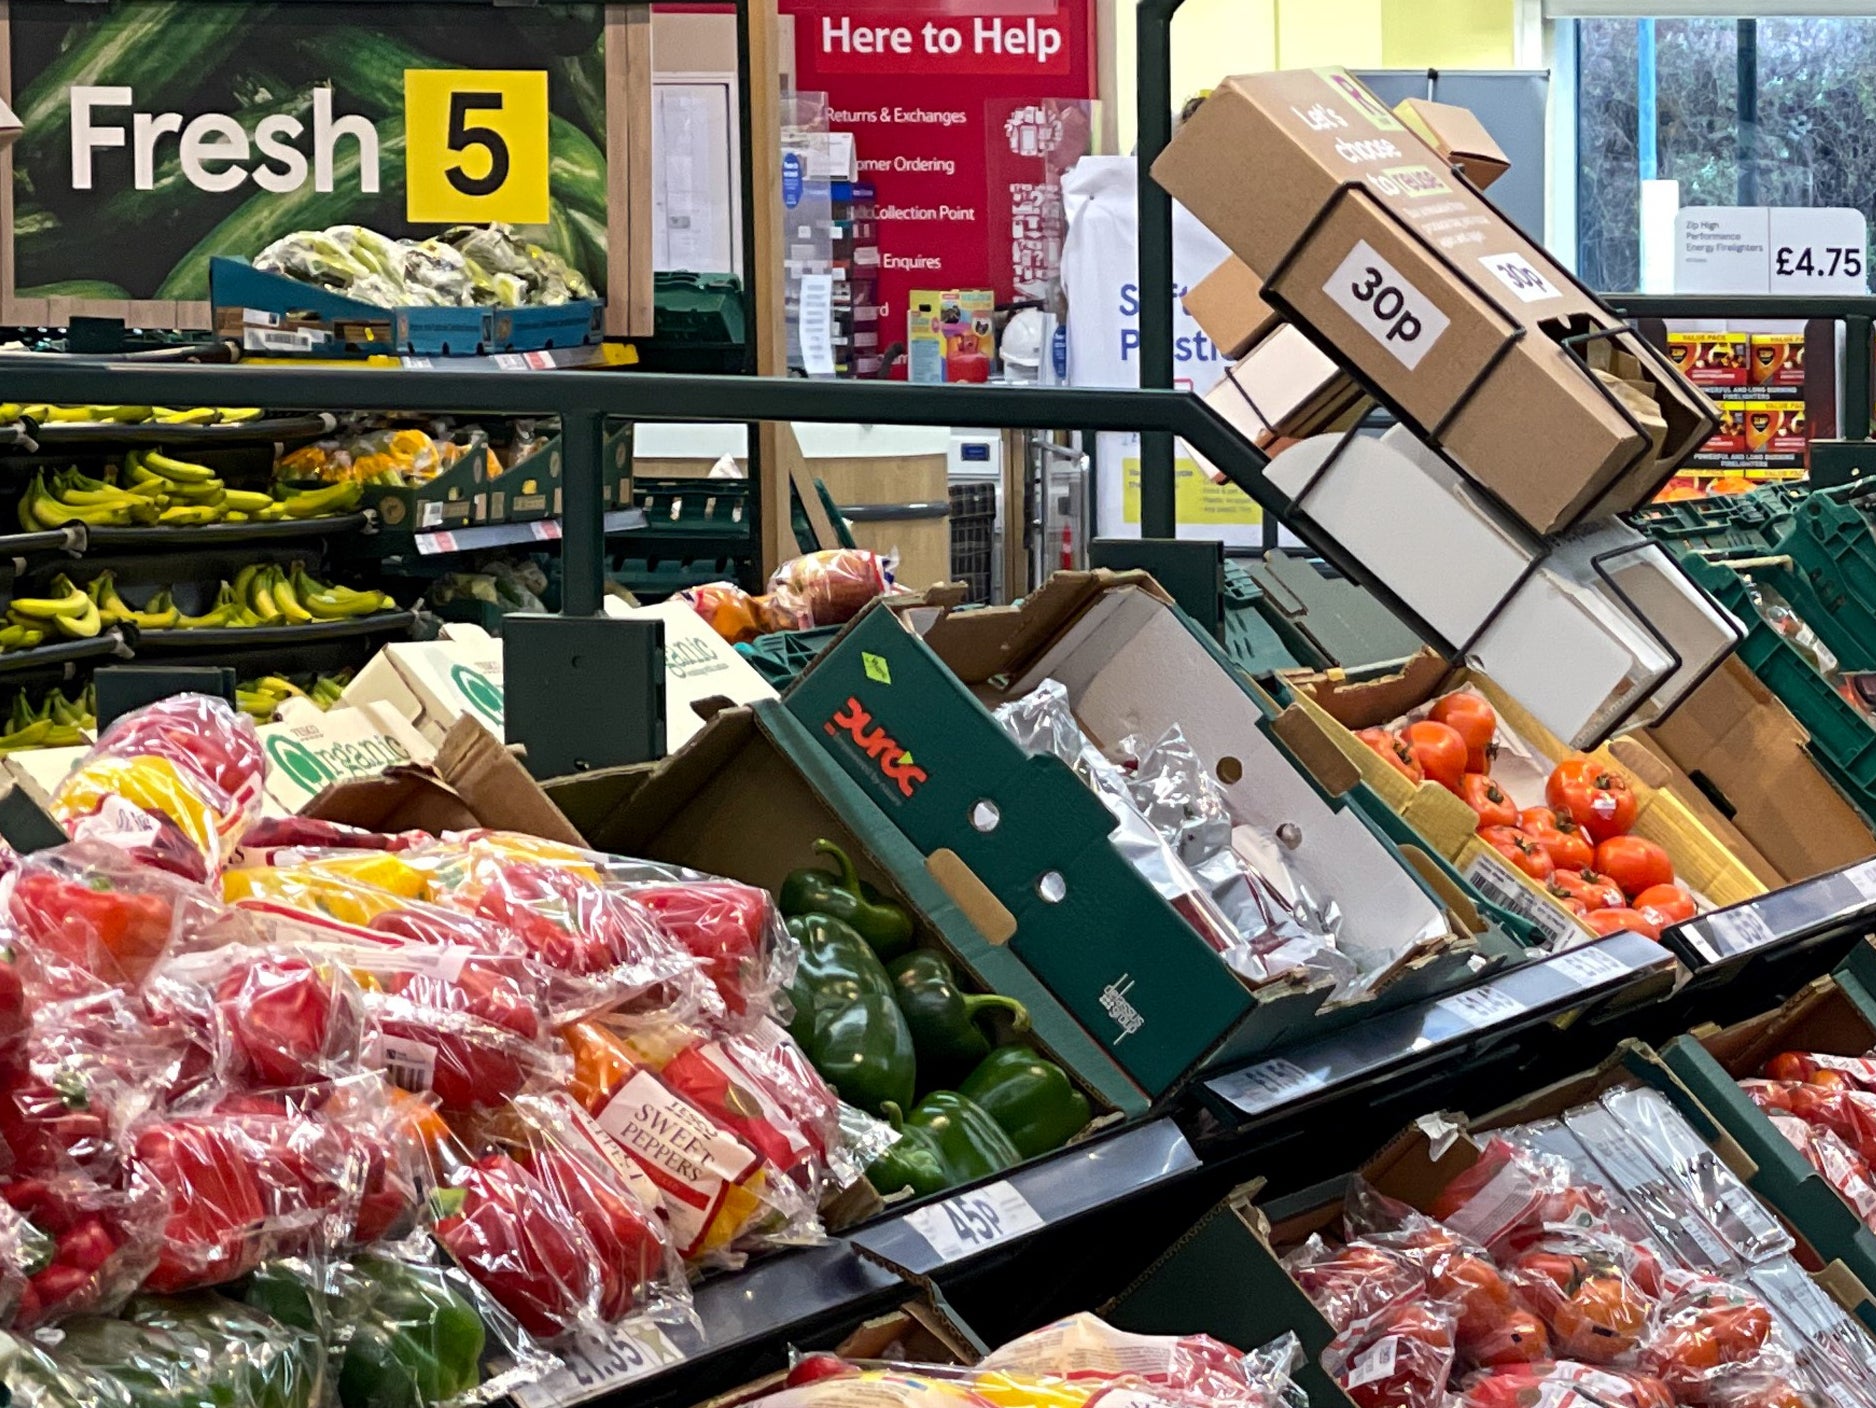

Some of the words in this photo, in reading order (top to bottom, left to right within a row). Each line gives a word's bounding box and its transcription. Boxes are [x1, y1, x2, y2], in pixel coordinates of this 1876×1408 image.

[822, 16, 912, 53] Here
[921, 21, 962, 54] to
[973, 17, 1062, 63] Help
[826, 107, 877, 123] Returns
[880, 108, 892, 123] &
[894, 108, 967, 126] Exchanges
[70, 86, 380, 194] Fresh
[445, 92, 510, 197] 5
[893, 157, 955, 175] Ordering
[873, 204, 938, 220] Collection
[939, 205, 976, 221] Point
[1685, 232, 1741, 242] Performance
[883, 253, 942, 272] Enquires
[1497, 262, 1548, 294] 30p
[1776, 247, 1862, 277] £4.75
[1351, 266, 1423, 343] 30p
[634, 1103, 716, 1165] SWEET
[620, 1121, 701, 1183] PEPPERS
[941, 1196, 1004, 1244] 45p
